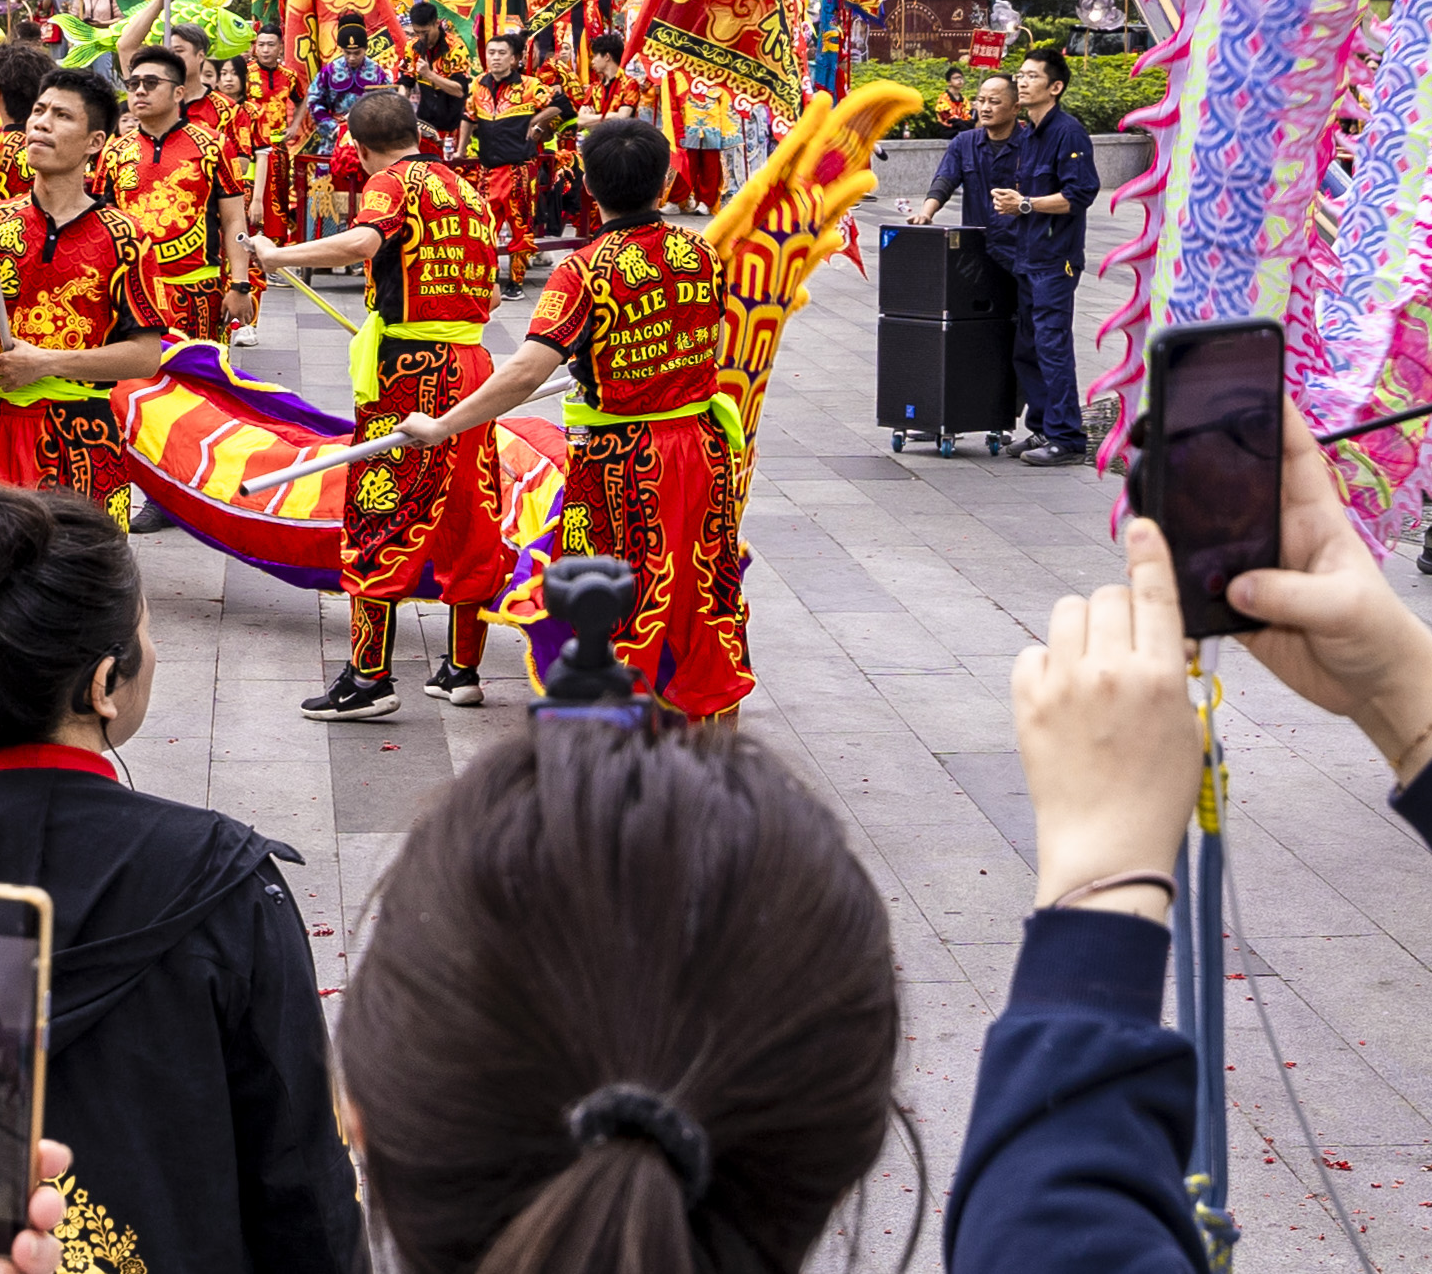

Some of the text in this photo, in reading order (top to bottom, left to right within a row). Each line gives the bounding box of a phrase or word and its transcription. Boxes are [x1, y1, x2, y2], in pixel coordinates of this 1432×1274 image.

[429, 216, 491, 245] LIE DE
[614, 232, 701, 285] 獵德
[420, 284, 456, 295] DANCE
[624, 281, 711, 323] LIE DE
[610, 319, 672, 346] DRAGON
[612, 366, 655, 380] DANCE
